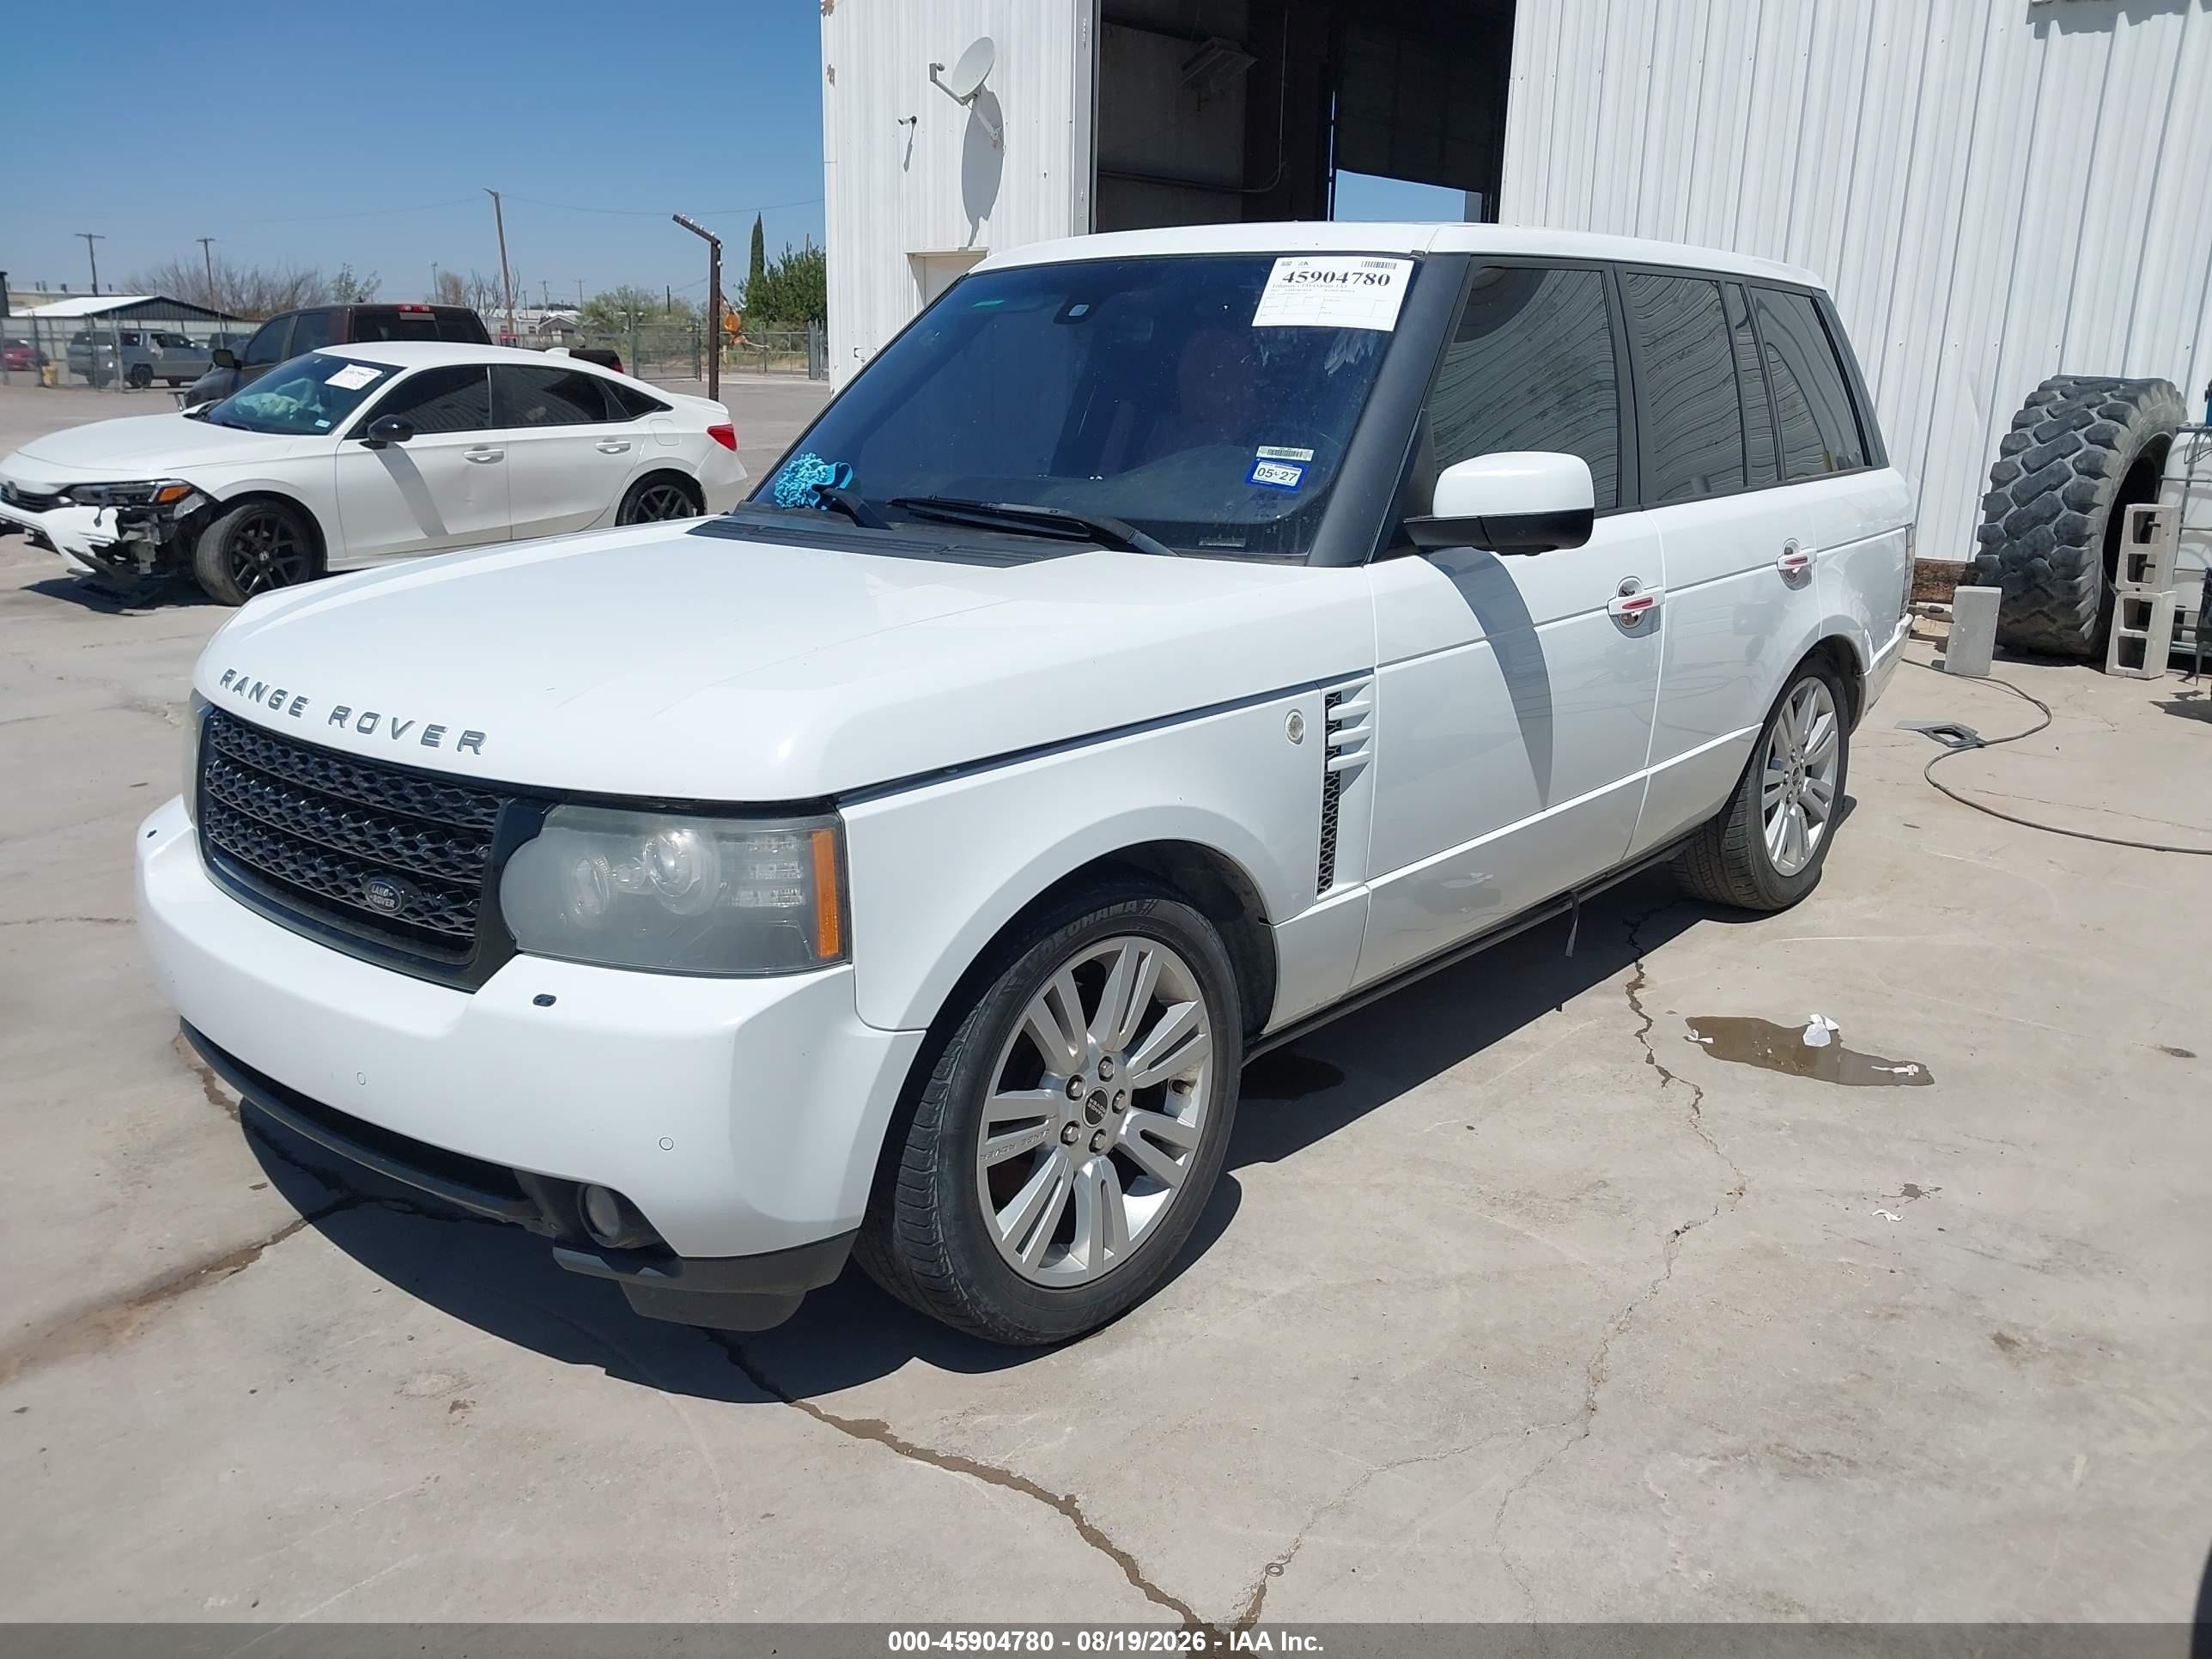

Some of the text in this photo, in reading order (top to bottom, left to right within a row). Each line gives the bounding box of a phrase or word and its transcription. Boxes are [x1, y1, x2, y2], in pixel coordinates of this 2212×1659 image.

[1282, 270, 1391, 286] 45904780
[1257, 467, 1275, 478] 05
[1279, 471, 1298, 482] 27
[219, 668, 488, 756] RANGE ROVER
[373, 894, 395, 908] ROVER
